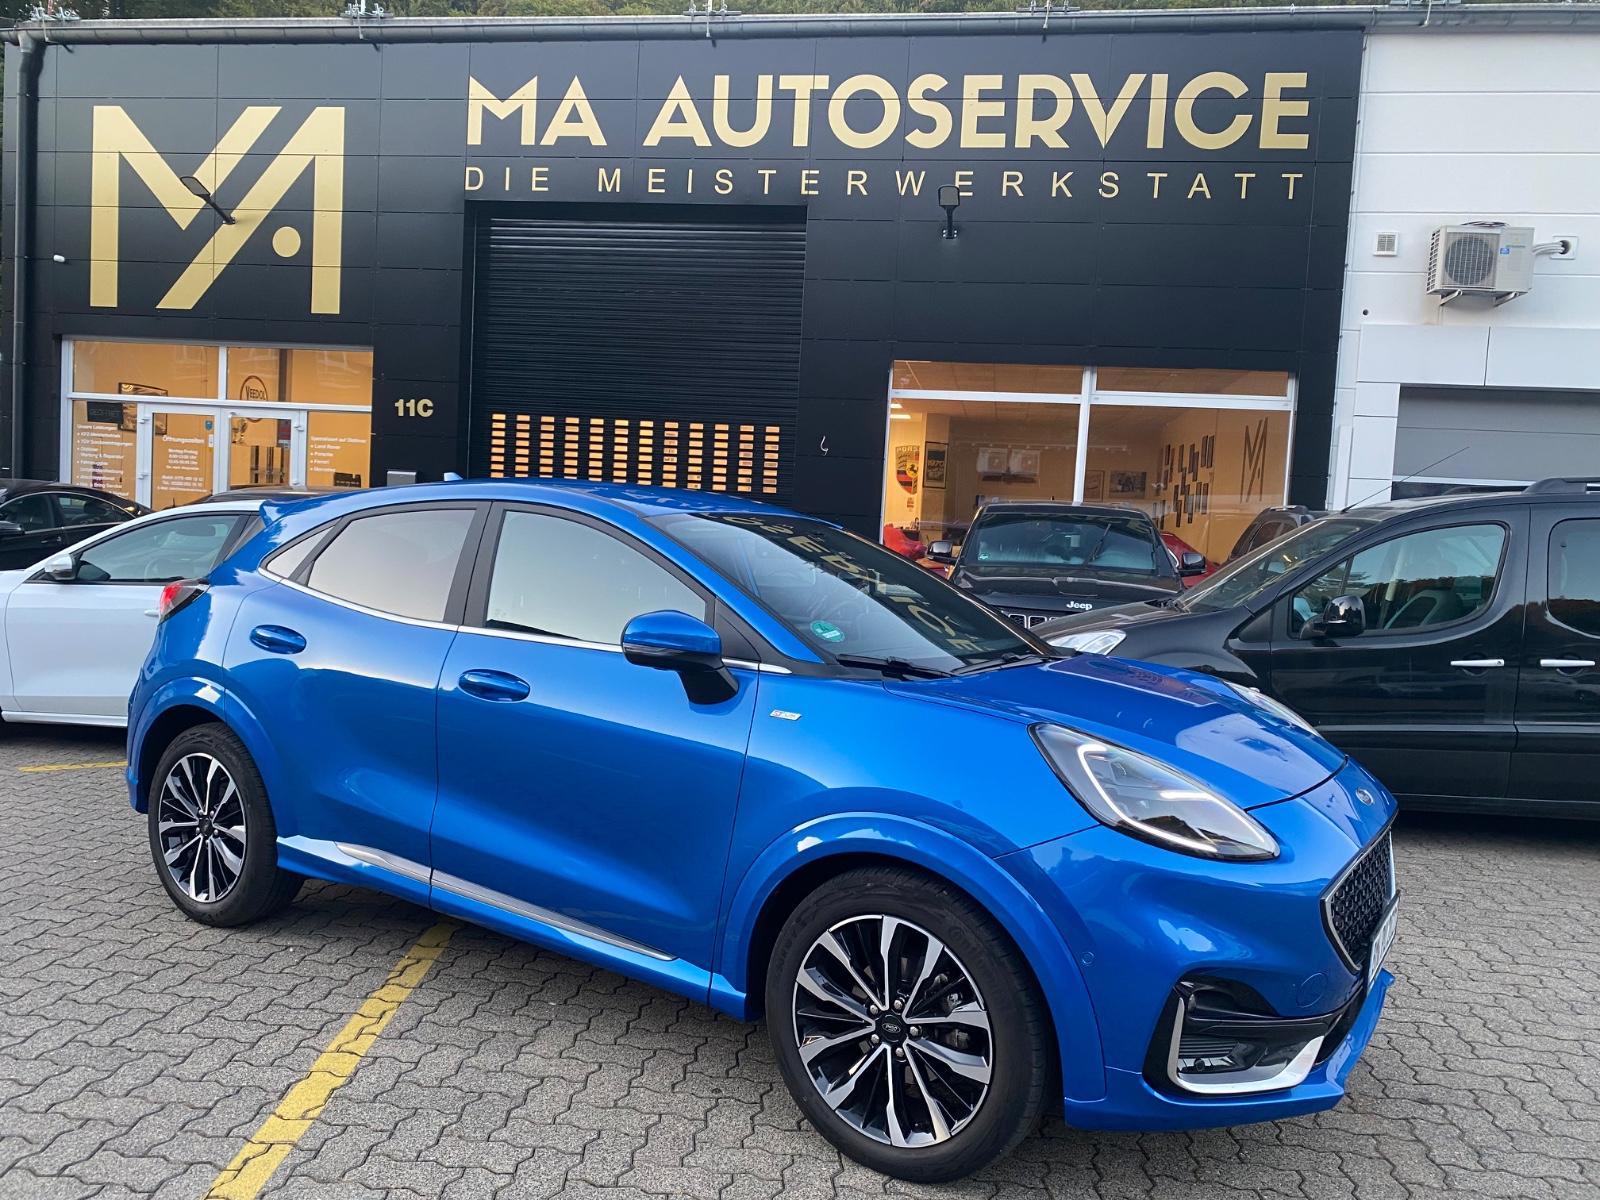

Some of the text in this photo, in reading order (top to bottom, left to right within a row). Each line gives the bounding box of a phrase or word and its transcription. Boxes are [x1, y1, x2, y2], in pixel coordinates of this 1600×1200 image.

[466, 71, 1310, 150] MA AUTOSERVICE
[464, 166, 1303, 200] DIE MEISTERWERKSTATT
[394, 398, 434, 417] 11C
[1066, 600, 1093, 611] Jeep
